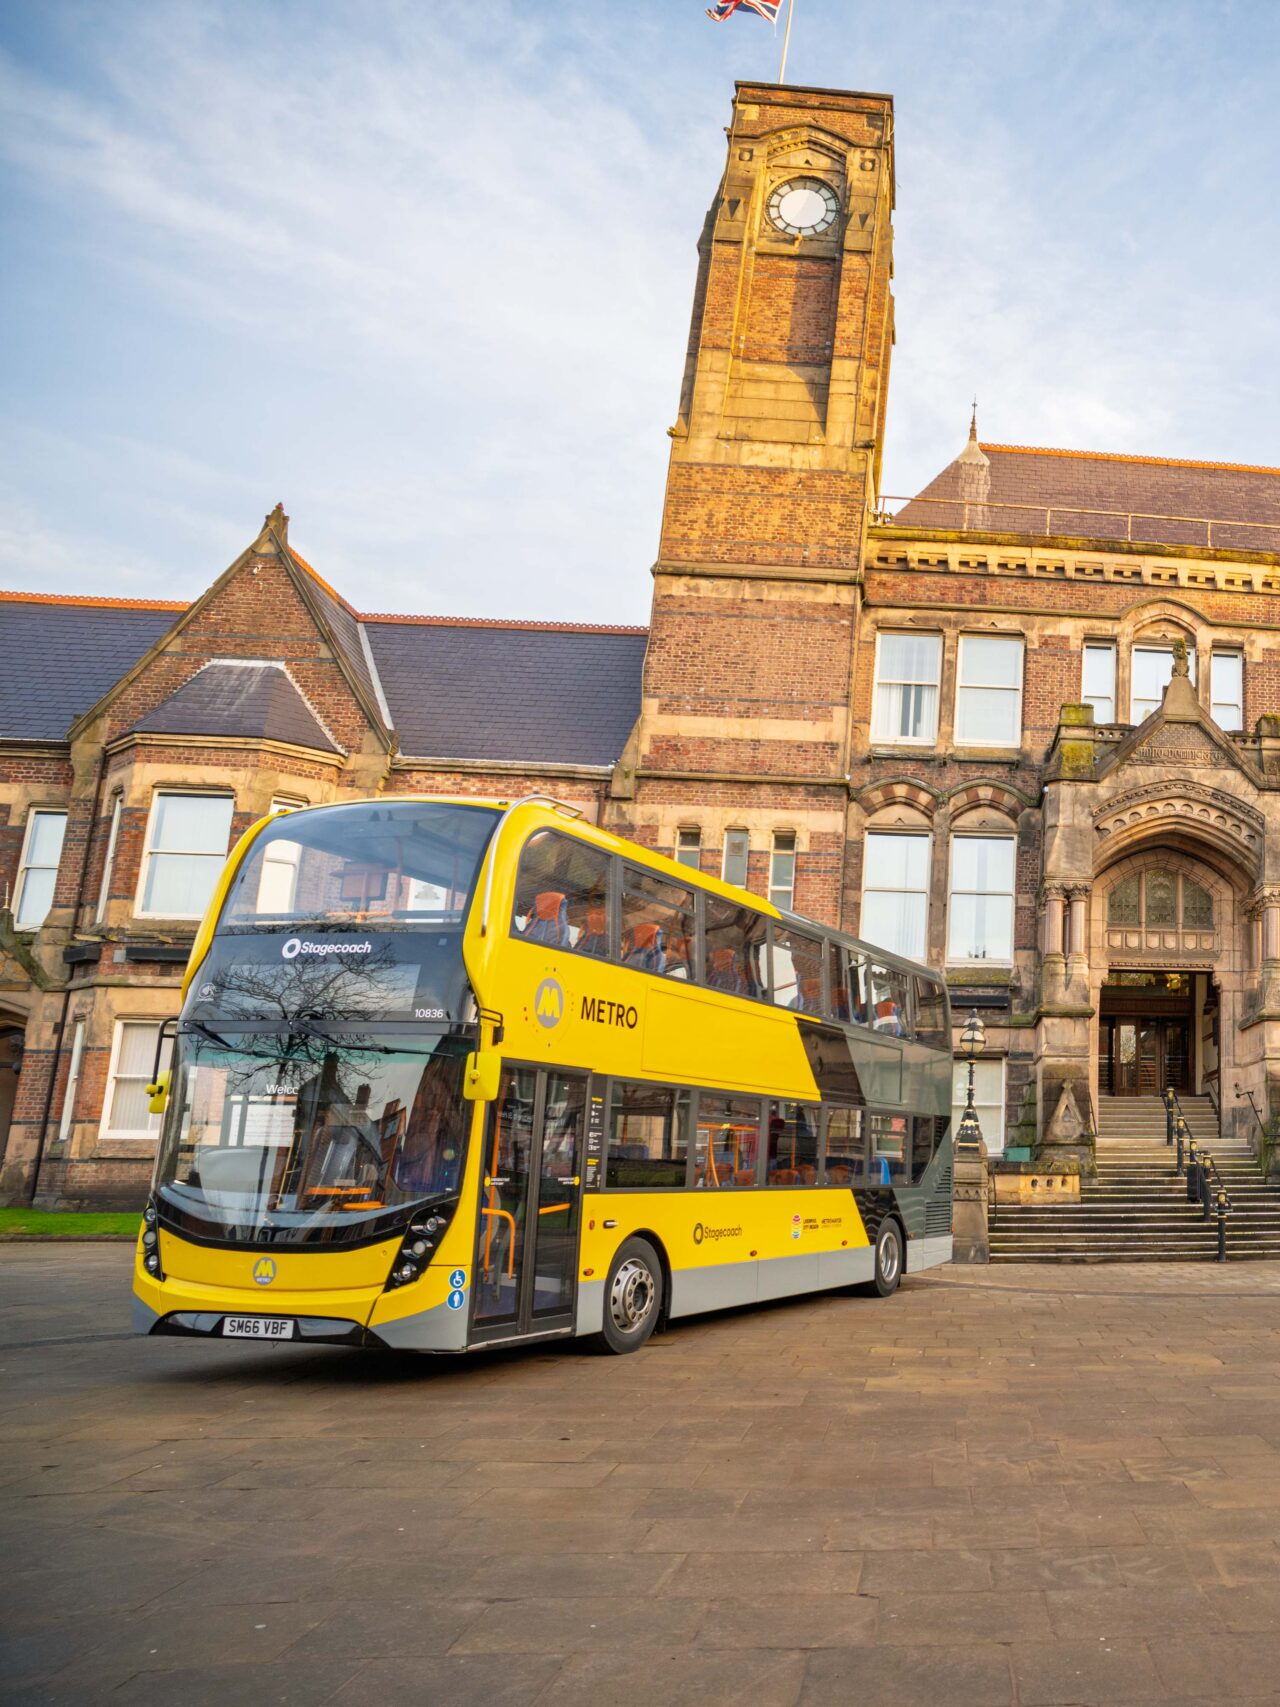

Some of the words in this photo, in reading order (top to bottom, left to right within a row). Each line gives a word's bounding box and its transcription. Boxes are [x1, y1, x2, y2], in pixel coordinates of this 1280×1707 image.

[300, 941, 372, 957] Stagecoach
[415, 1008, 445, 1019] 10836
[580, 996, 639, 1029] METRO
[704, 1225, 743, 1241] Stagecoach
[228, 1319, 260, 1335] SM66
[264, 1320, 288, 1336] VBF
